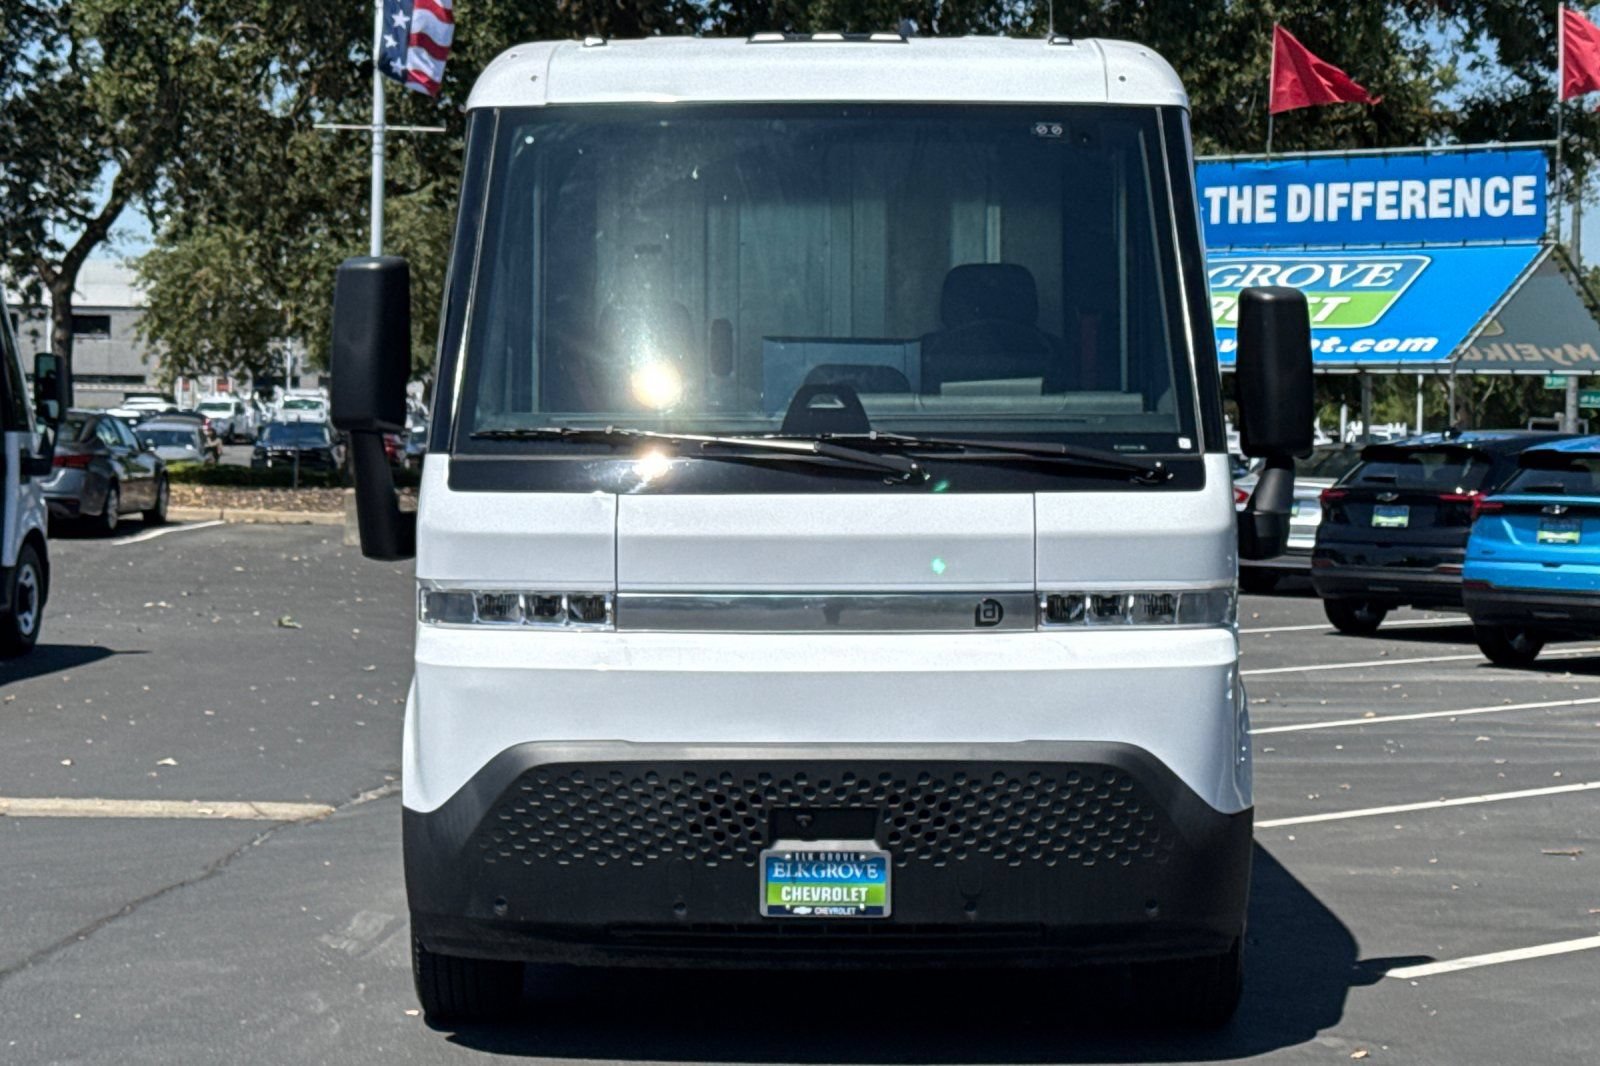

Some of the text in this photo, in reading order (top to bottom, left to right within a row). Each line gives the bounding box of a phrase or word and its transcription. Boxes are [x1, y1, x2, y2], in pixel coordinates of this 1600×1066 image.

[1204, 175, 1537, 225] THE DIFFERENCE
[1208, 263, 1403, 288] GROVE
[772, 862, 878, 879] ELK GROVE
[781, 885, 868, 902] CHEVROLET
[814, 907, 856, 915] CHEVROLET
